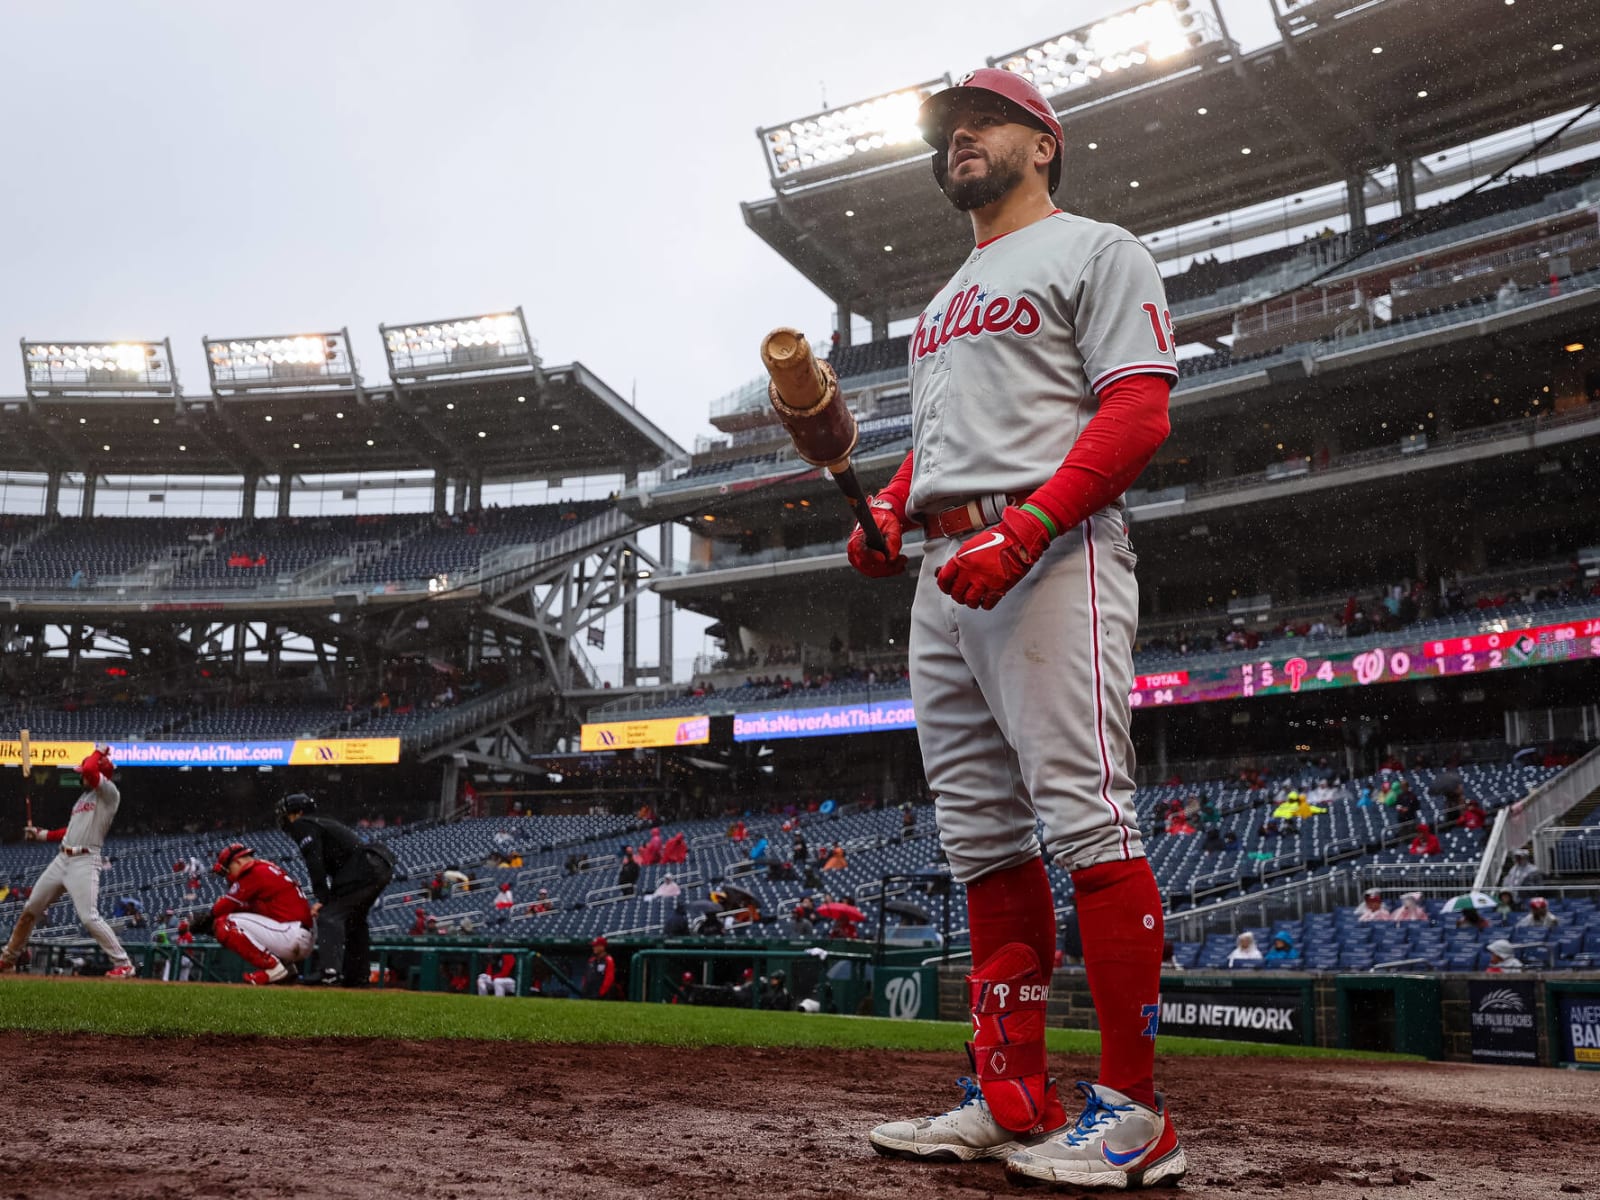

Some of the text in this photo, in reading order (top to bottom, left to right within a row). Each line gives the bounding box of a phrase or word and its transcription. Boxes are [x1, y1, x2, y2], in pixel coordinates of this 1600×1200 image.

[908, 284, 1040, 366] hillies
[1316, 660, 1334, 683] 4
[1435, 650, 1503, 675] 1 2 2
[1146, 673, 1181, 688] TOTAL
[42, 747, 70, 761] pro.
[1161, 1003, 1294, 1031] MLB NETWORK
